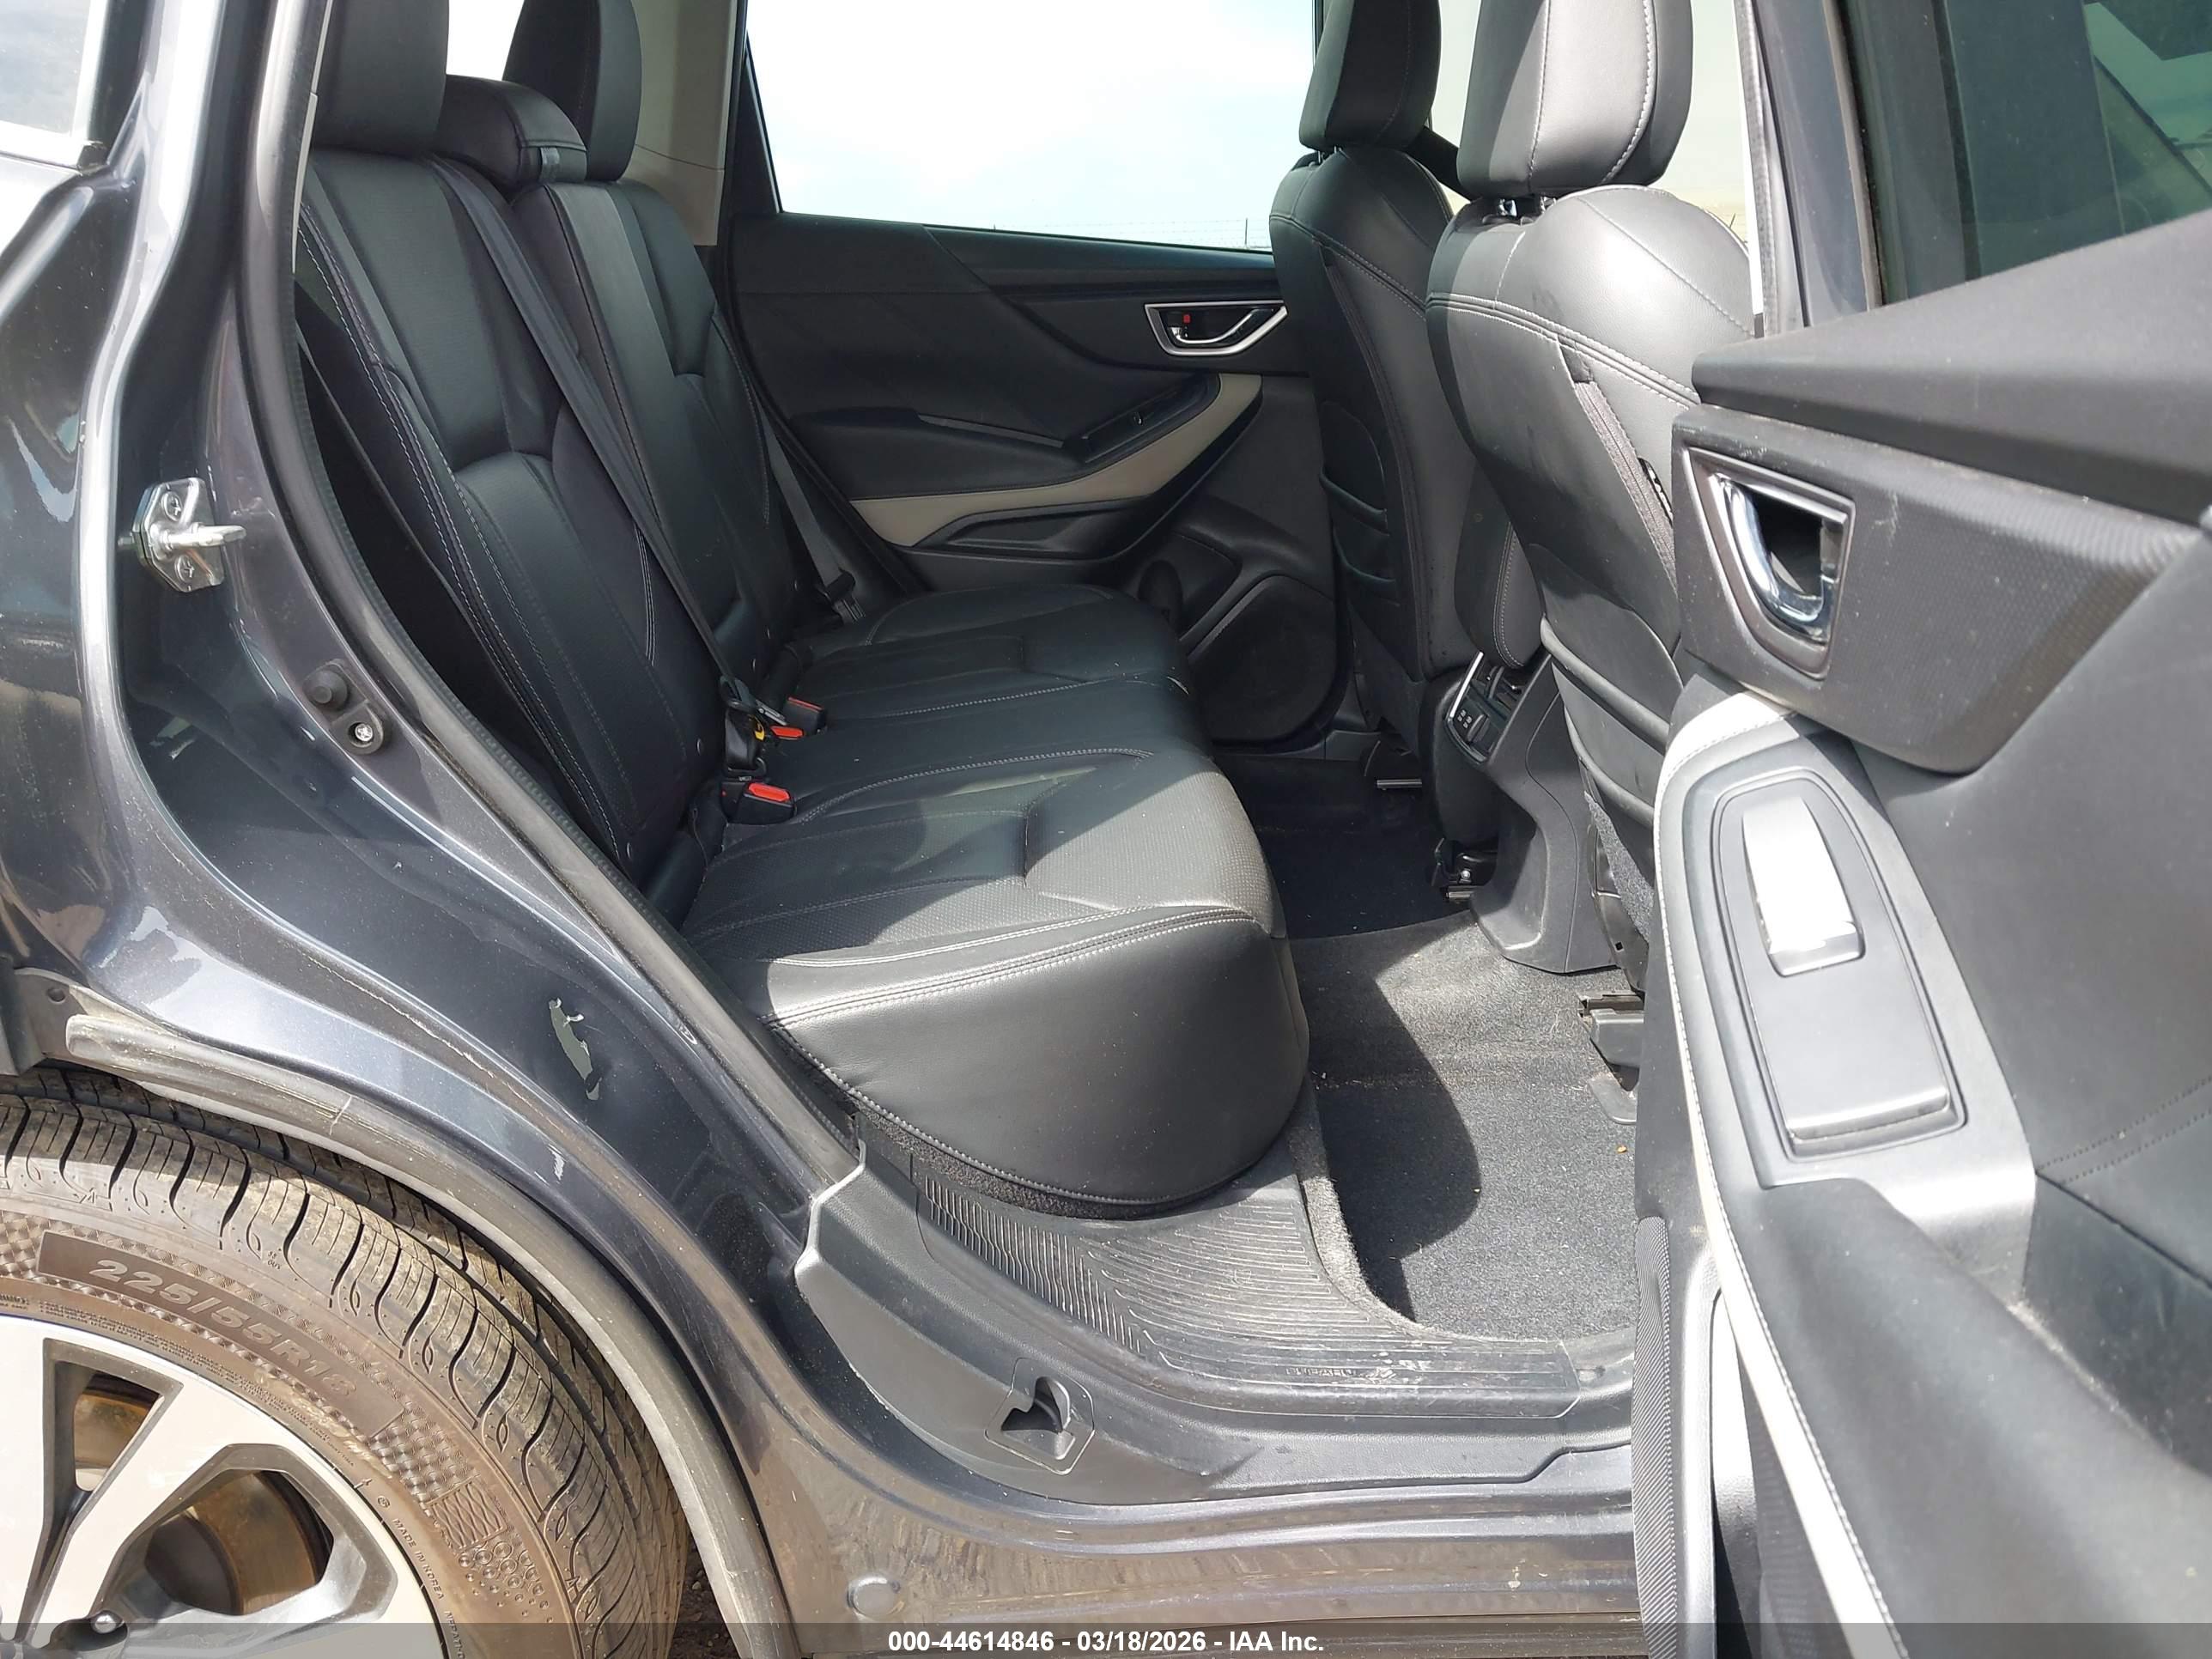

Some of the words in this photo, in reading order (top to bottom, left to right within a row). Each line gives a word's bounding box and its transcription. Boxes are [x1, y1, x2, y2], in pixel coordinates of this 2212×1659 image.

[88, 1259, 357, 1396] 225/55R18
[392, 1518, 416, 1548] MADE
[414, 1550, 425, 1563] IN
[422, 1565, 445, 1600] KOREA
